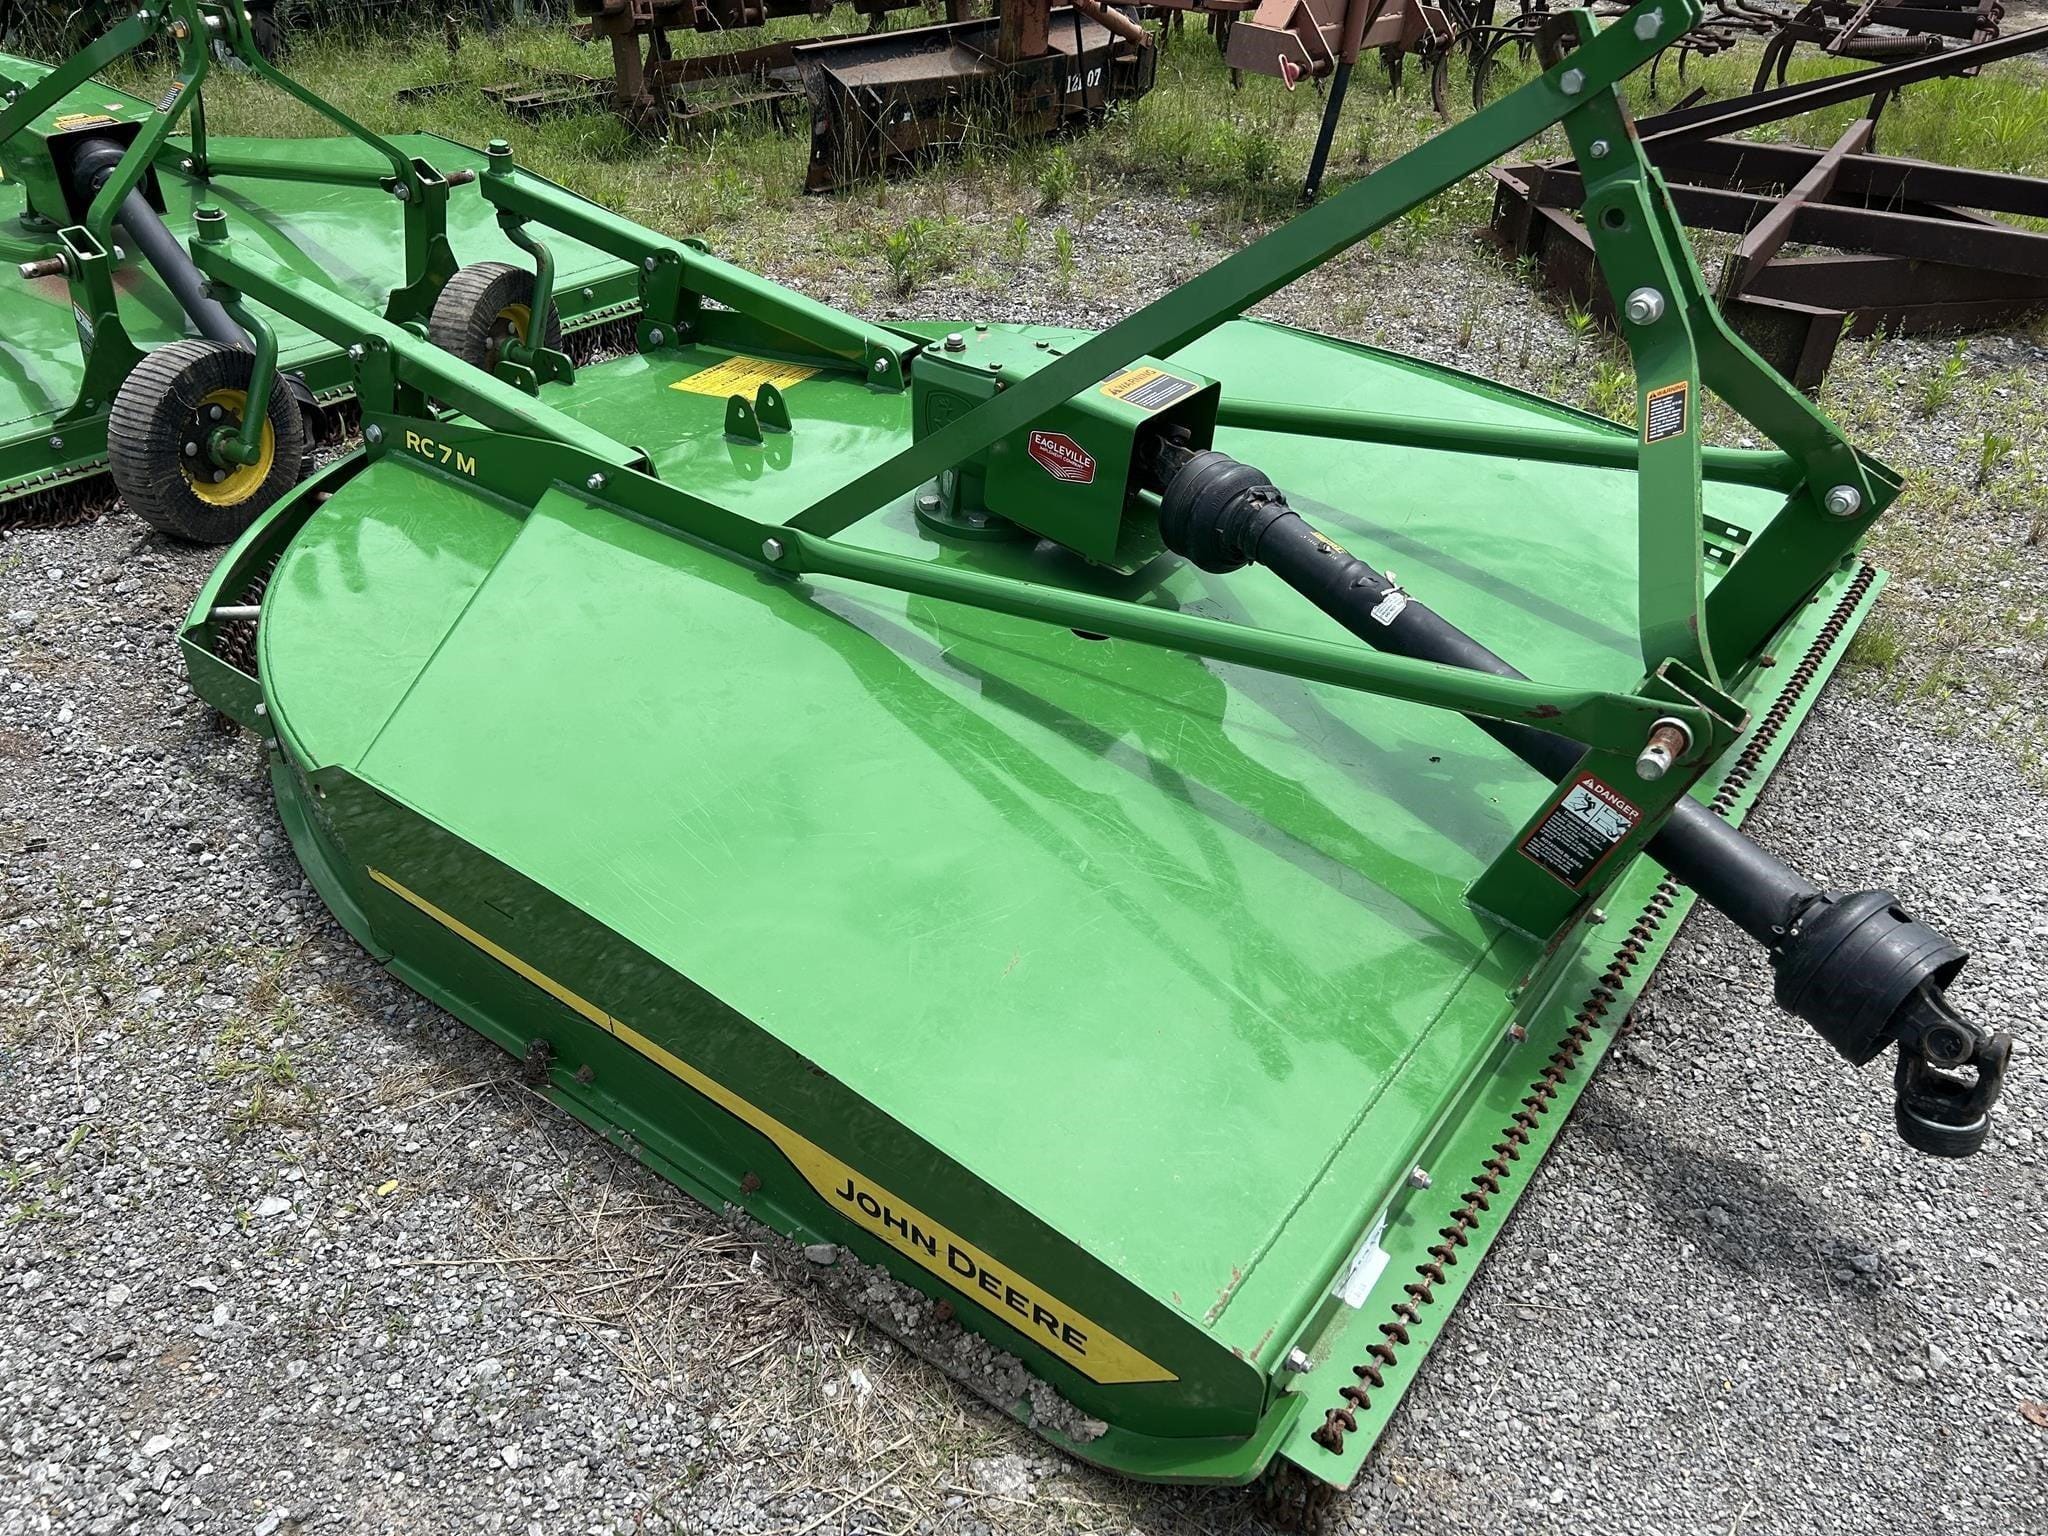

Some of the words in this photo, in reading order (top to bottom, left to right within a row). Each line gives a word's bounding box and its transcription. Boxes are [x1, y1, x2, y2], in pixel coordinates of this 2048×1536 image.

[1035, 434, 1092, 468] EAGLEVILLE
[1594, 784, 1639, 818] DANGER
[835, 1178, 937, 1257] JOHN
[947, 1243, 1088, 1356] DEERE
